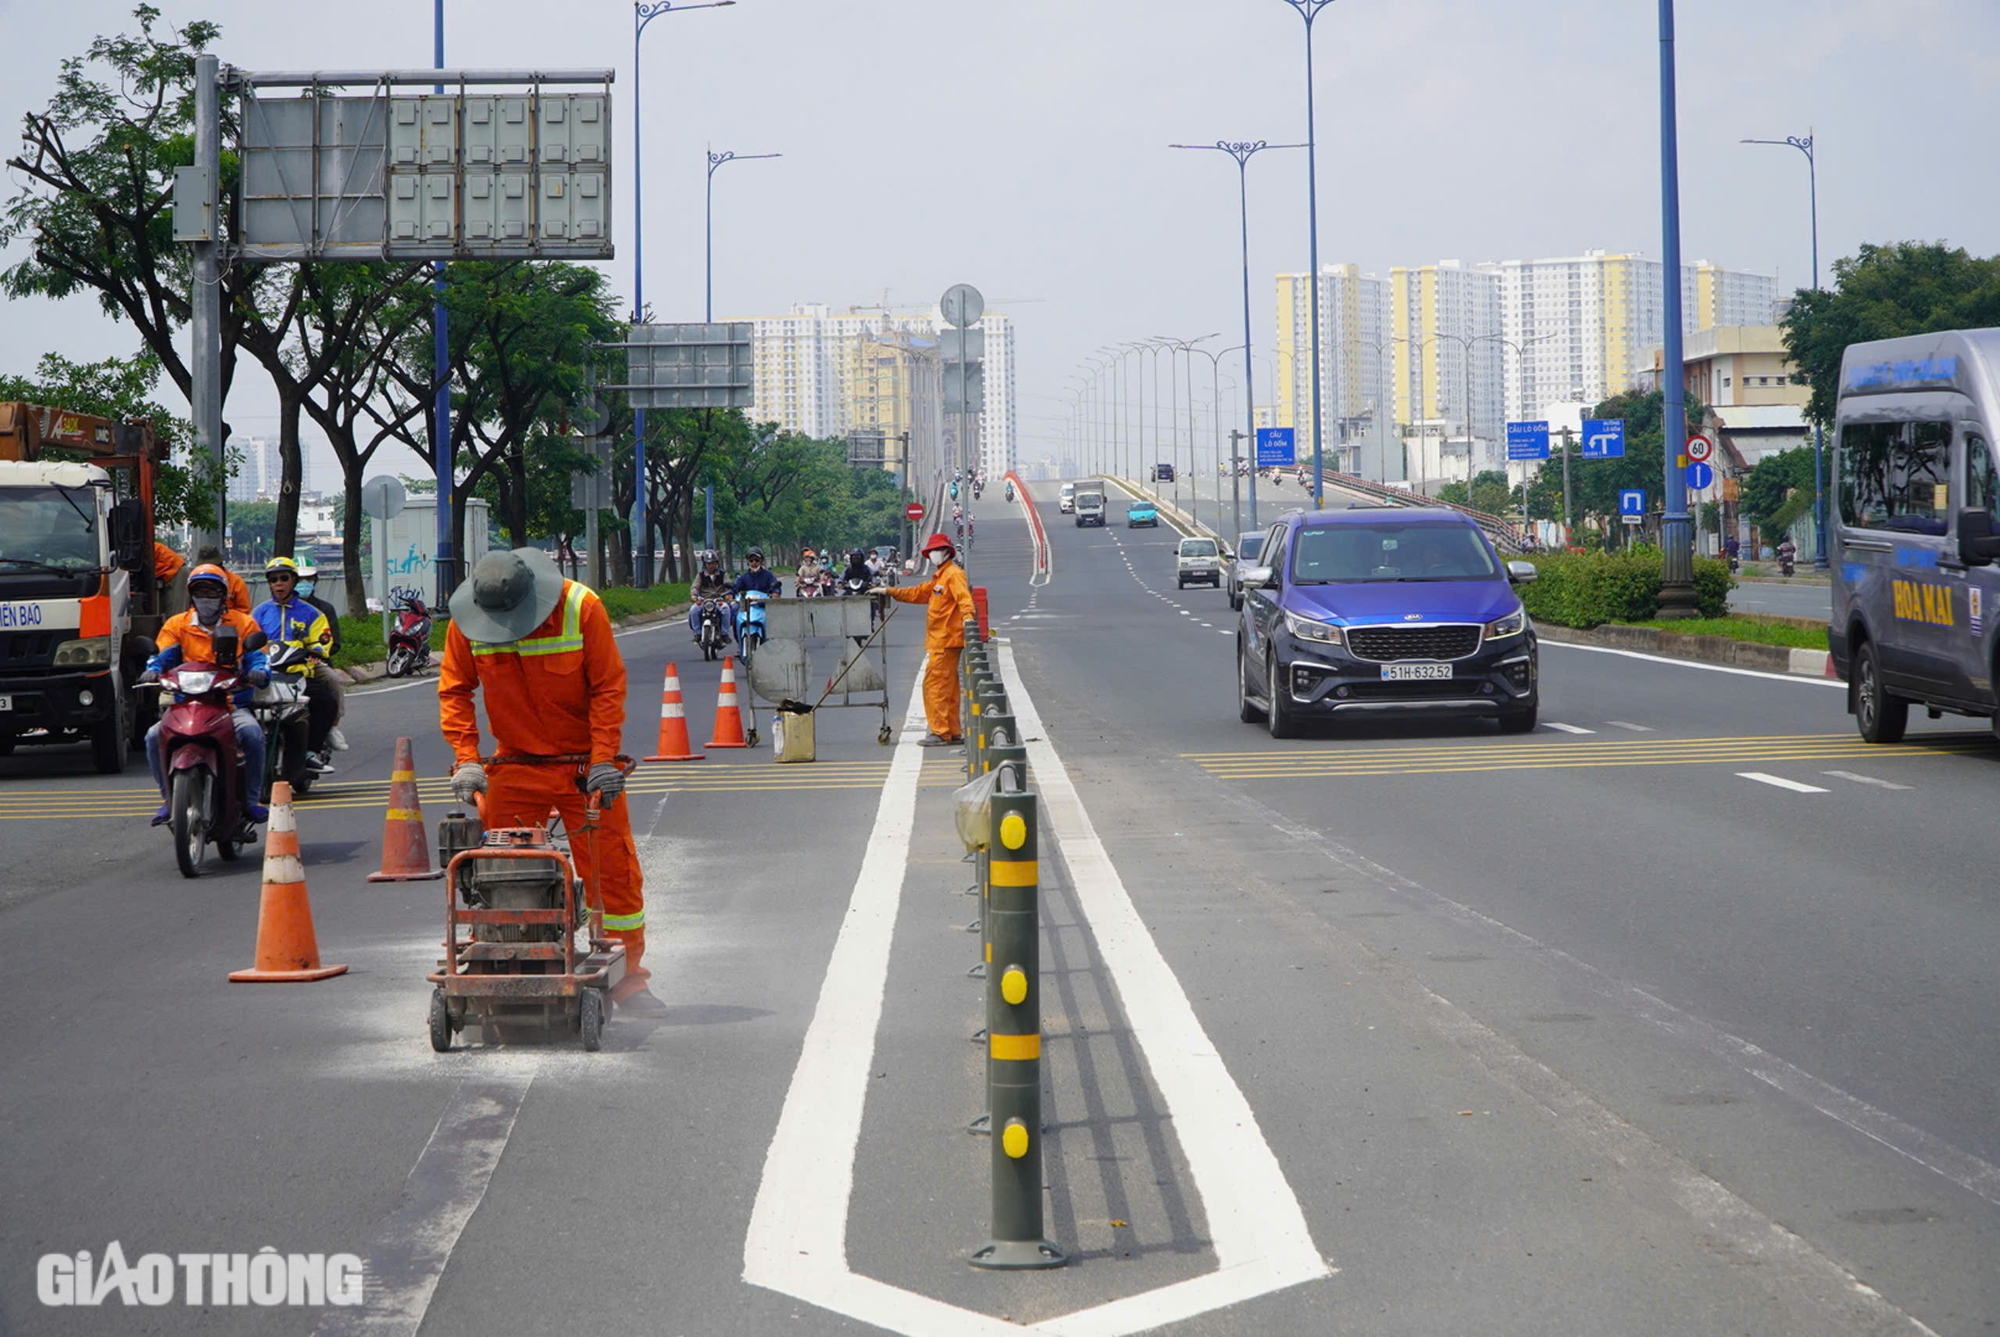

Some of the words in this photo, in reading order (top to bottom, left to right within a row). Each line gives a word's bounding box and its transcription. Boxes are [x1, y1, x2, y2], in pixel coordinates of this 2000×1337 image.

[1692, 442, 1704, 455] 60
[1893, 580, 1923, 622] HOA
[1922, 583, 1954, 626] MAI
